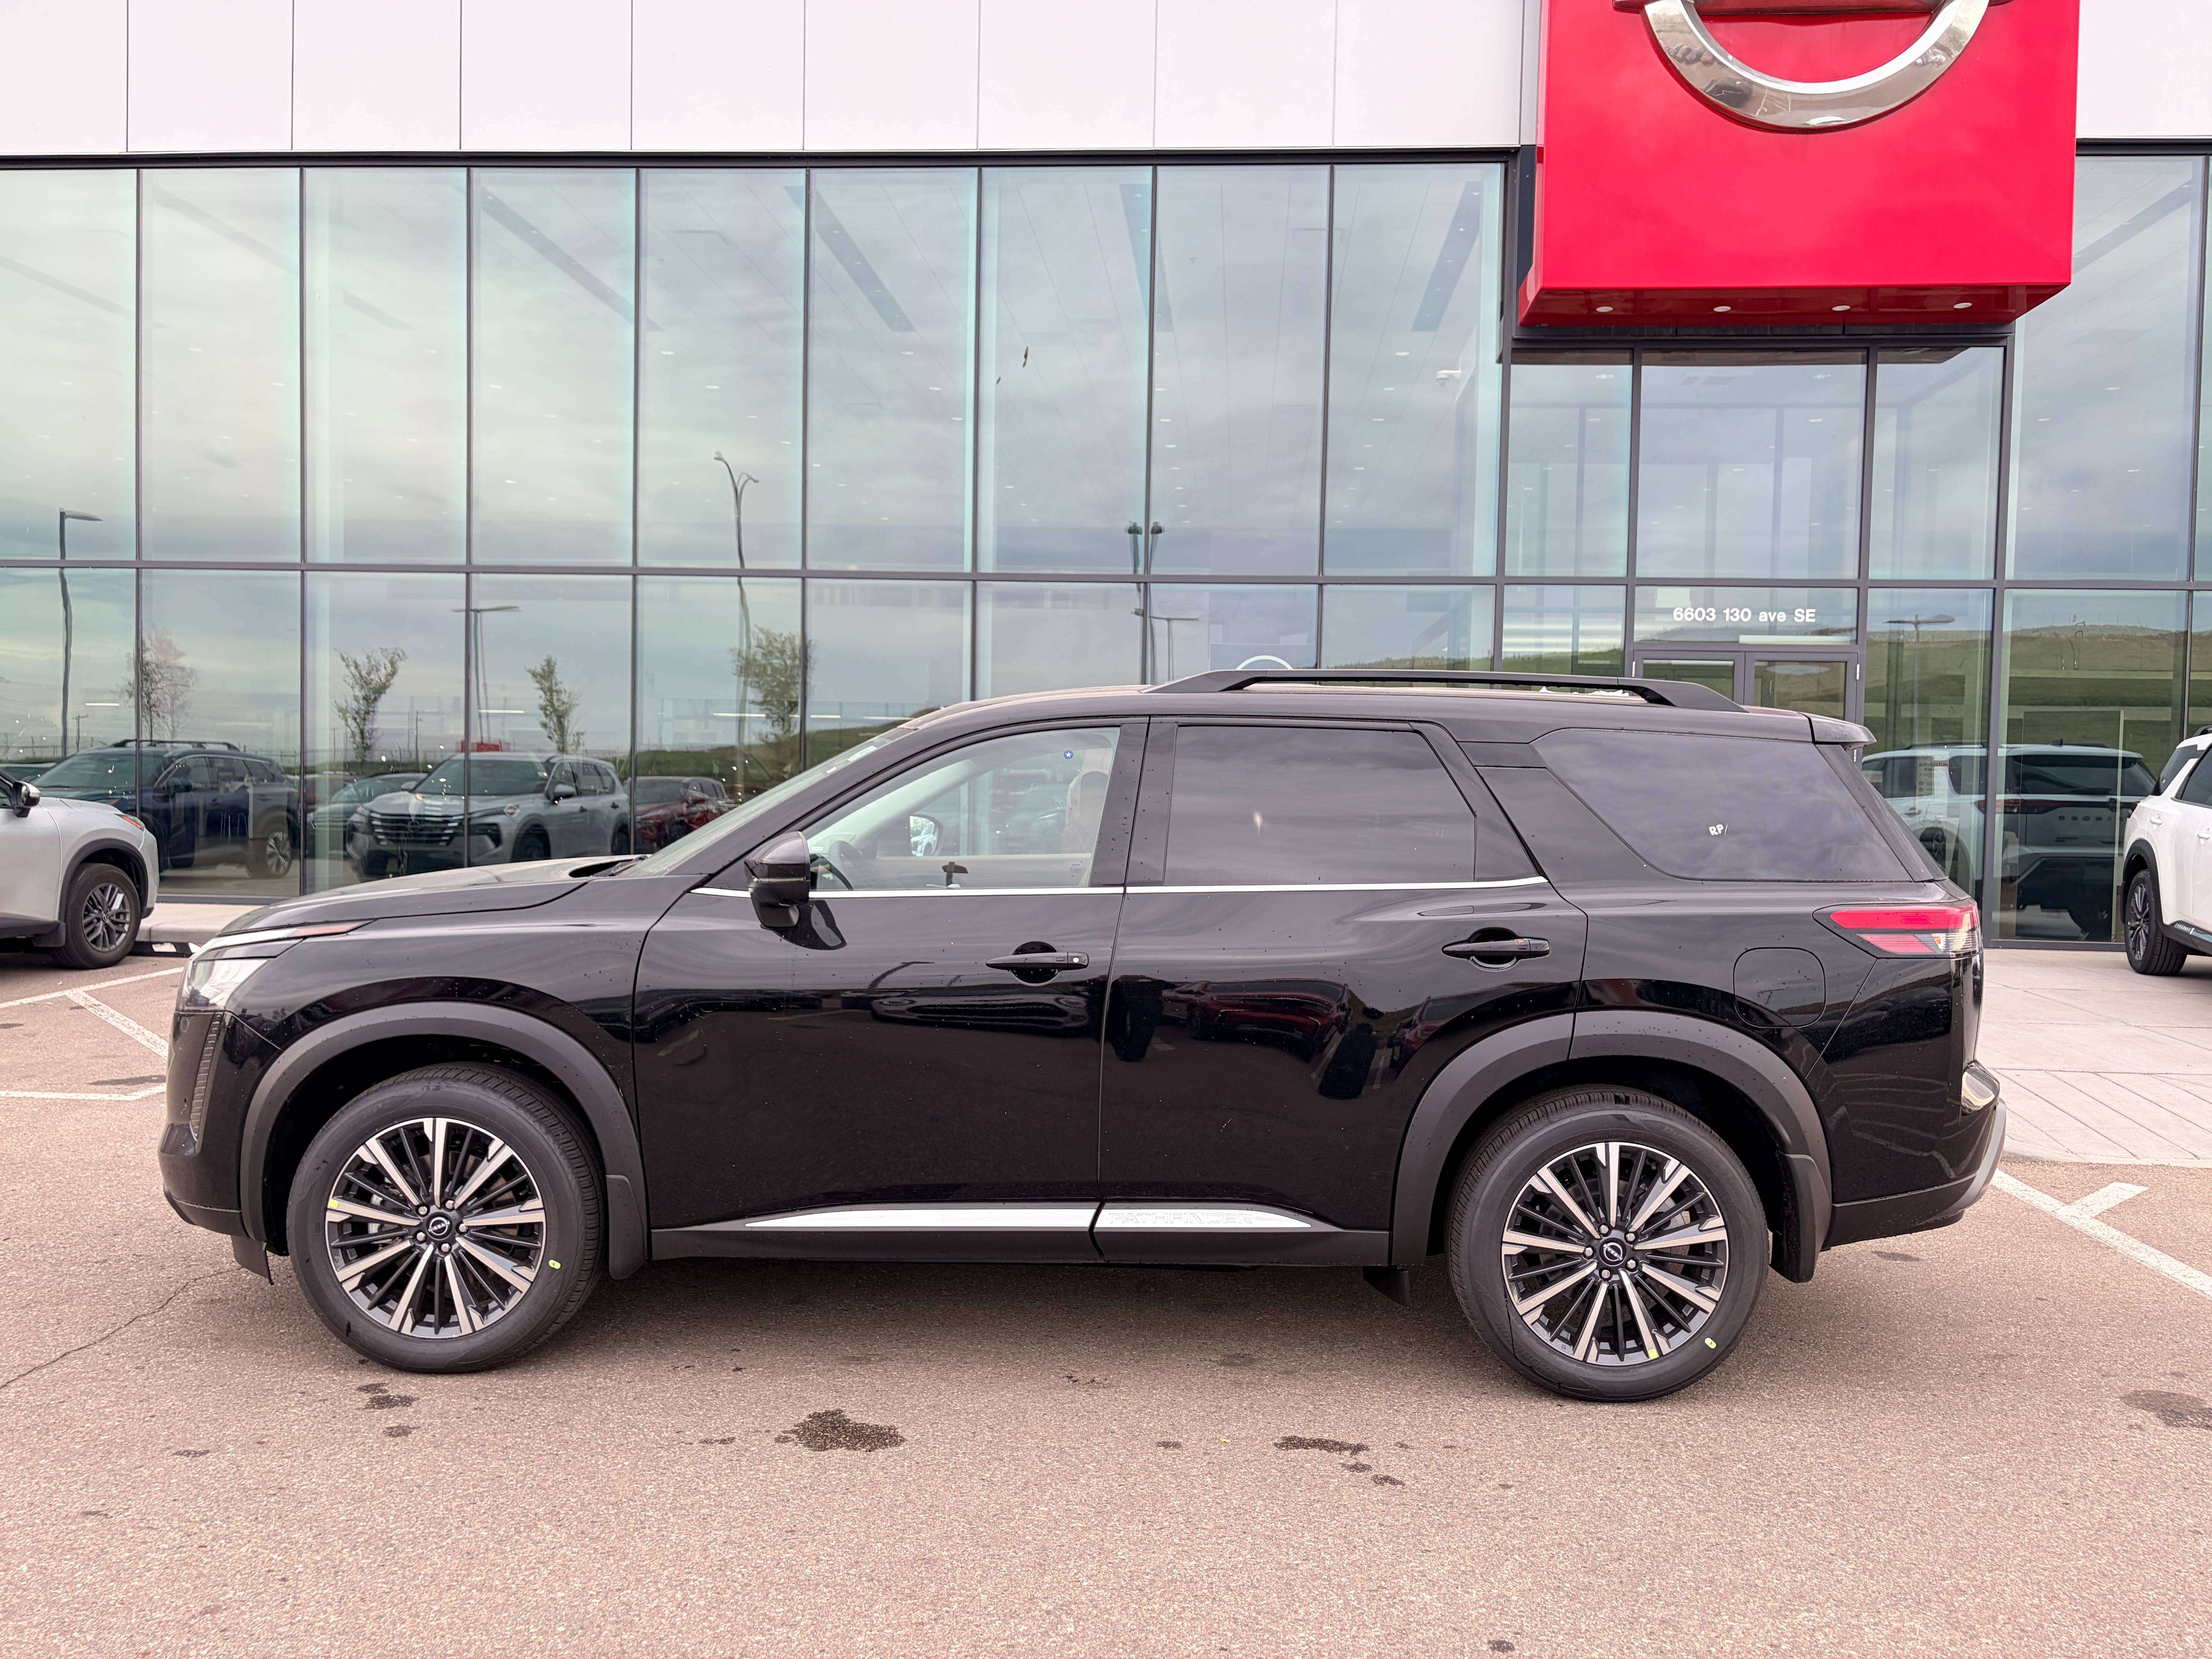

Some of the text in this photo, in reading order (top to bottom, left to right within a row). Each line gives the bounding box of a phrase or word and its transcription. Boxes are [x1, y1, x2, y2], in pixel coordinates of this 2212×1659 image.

[1673, 607, 1816, 622] 6603 130 ave SE
[1109, 1213, 1253, 1224] PATHFINDER
[428, 1221, 450, 1233] NISSAN
[1603, 1243, 1623, 1261] NISSAN
